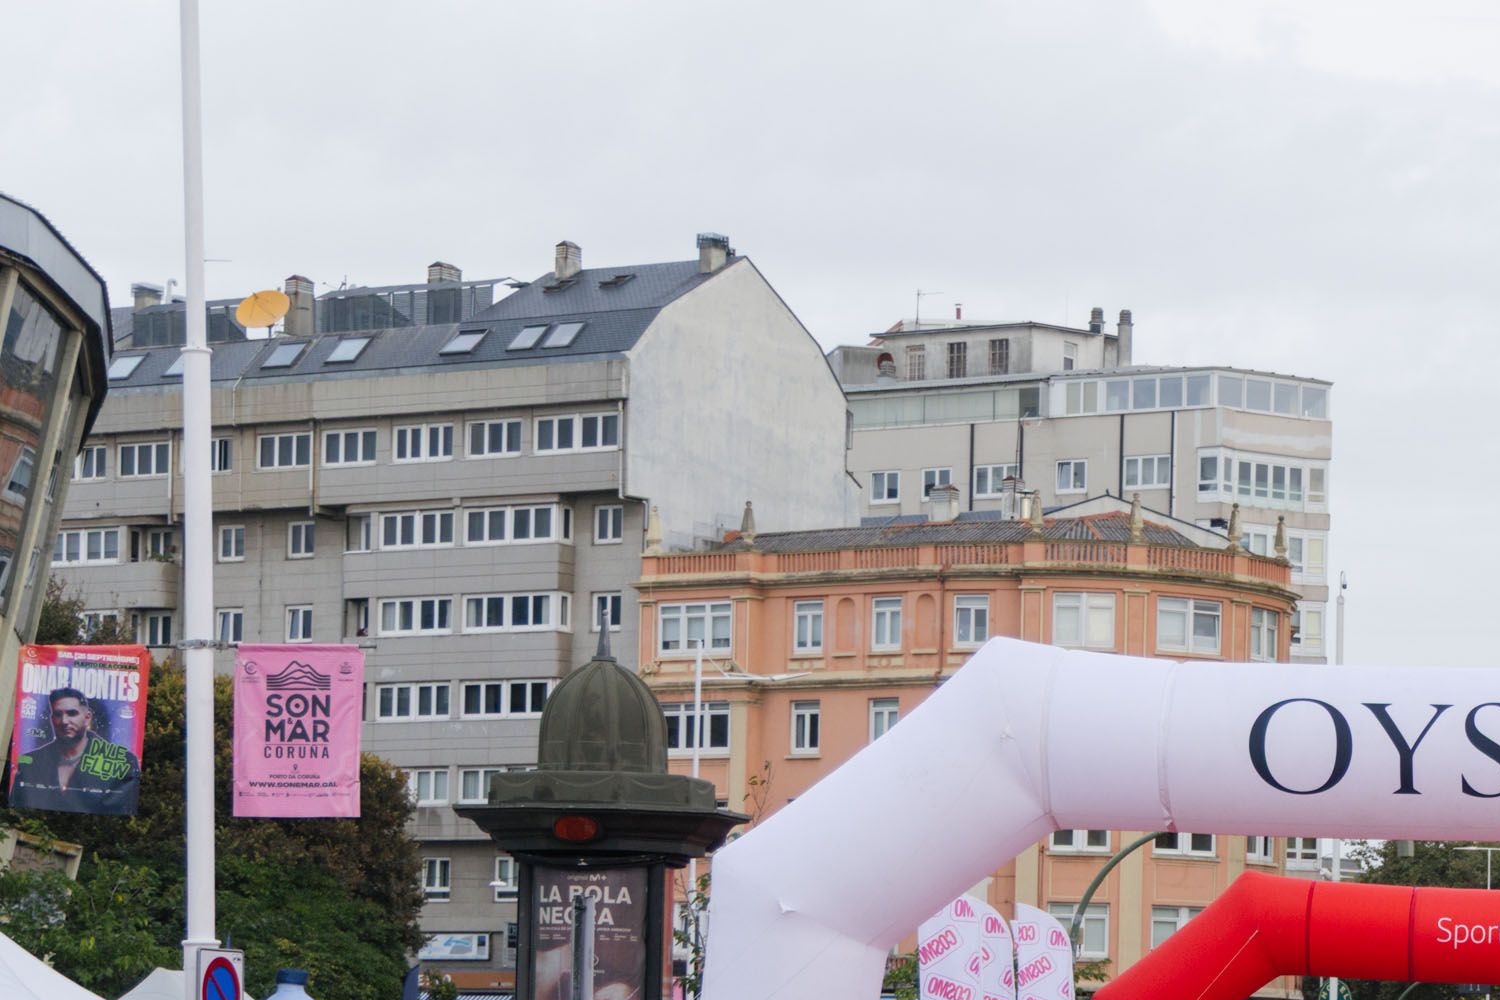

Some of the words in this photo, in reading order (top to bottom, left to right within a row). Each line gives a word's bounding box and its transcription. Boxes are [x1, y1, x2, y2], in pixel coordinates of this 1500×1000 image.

[22, 663, 69, 694] OMAR
[71, 667, 140, 702] MONTES
[265, 694, 331, 718] SON
[265, 719, 330, 743] MAR
[287, 717, 294, 725] &
[264, 744, 330, 759] CORUÑA
[540, 885, 562, 903] LA
